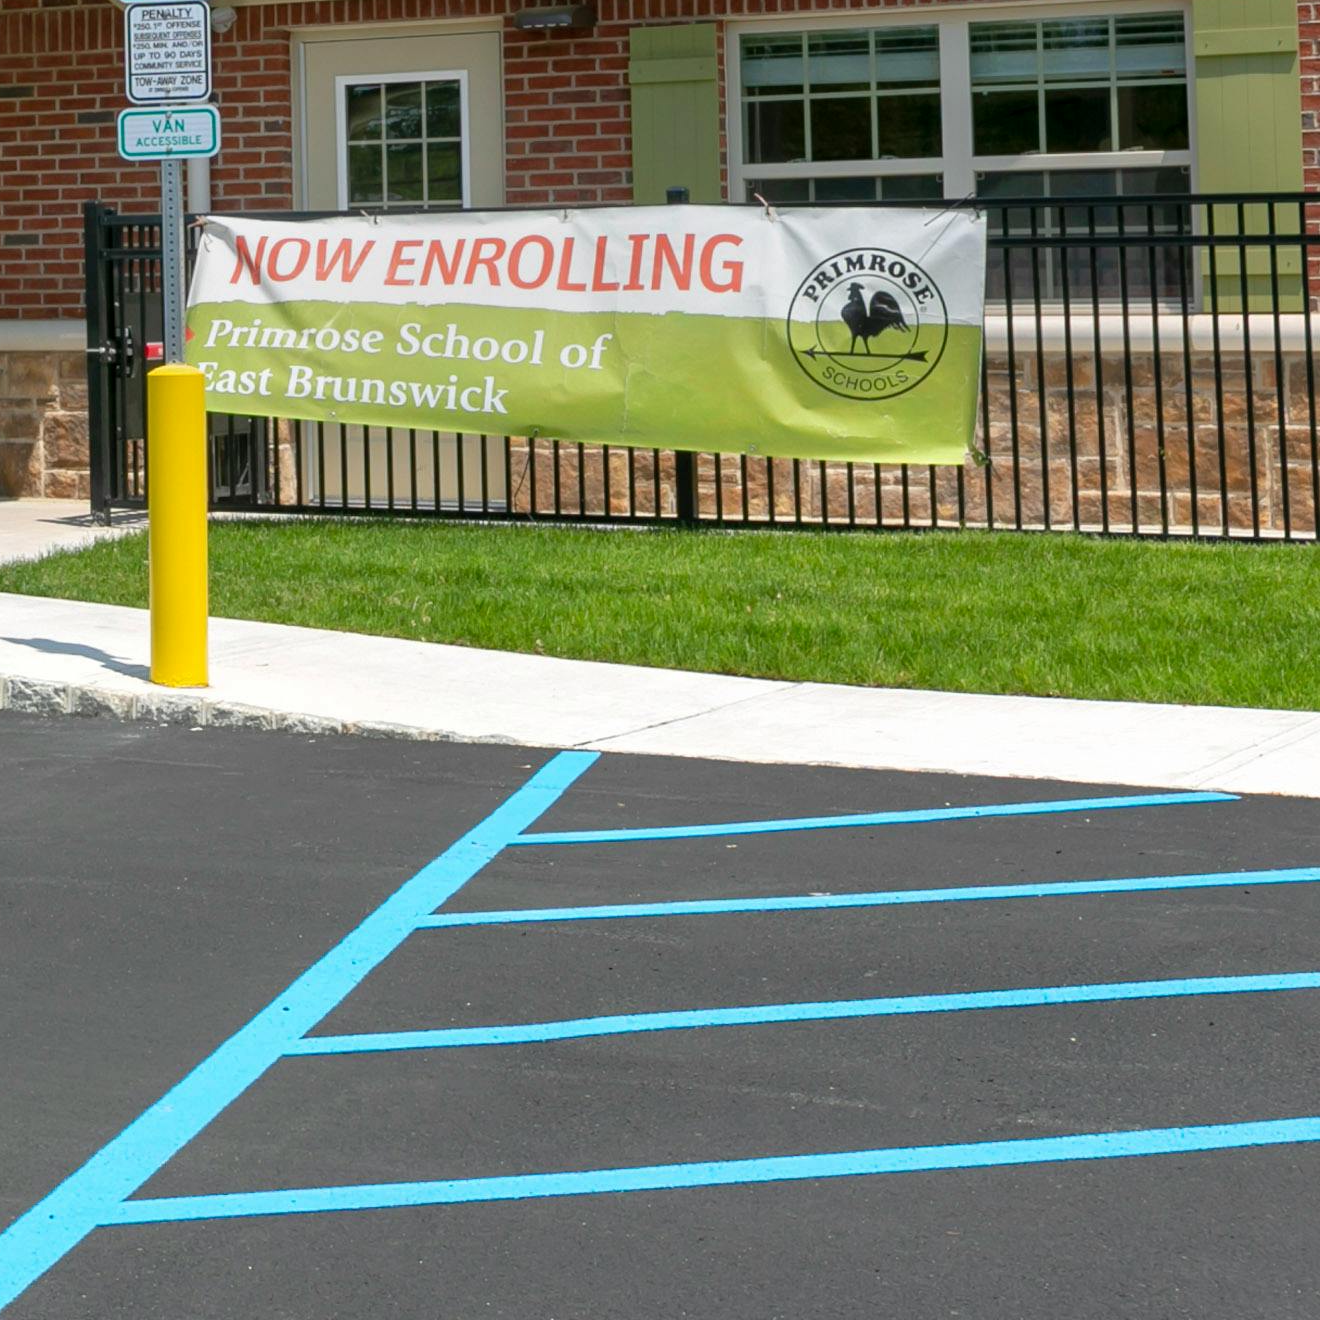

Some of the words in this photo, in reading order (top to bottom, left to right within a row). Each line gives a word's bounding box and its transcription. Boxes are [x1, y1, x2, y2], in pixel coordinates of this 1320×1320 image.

[142, 8, 193, 20] PENALTY
[165, 20, 202, 30] OFFENSE
[133, 52, 147, 61] UP
[149, 51, 162, 60] TO
[179, 49, 203, 59] DAYS
[175, 60, 203, 69] SERVICE
[134, 75, 177, 87] TOW-AWAY
[180, 74, 204, 85] ZONE
[152, 118, 186, 134] VAN
[135, 134, 203, 147] ACCESSIBLE
[229, 234, 376, 286] NOW
[382, 232, 745, 294] ENROLLING
[803, 253, 935, 306] PRIMROSE
[203, 318, 384, 355] Primrose
[395, 321, 545, 366] School
[559, 333, 613, 371] of
[821, 364, 910, 393] SCHOOLS
[197, 361, 274, 397] East
[284, 364, 510, 415] Brunswick
